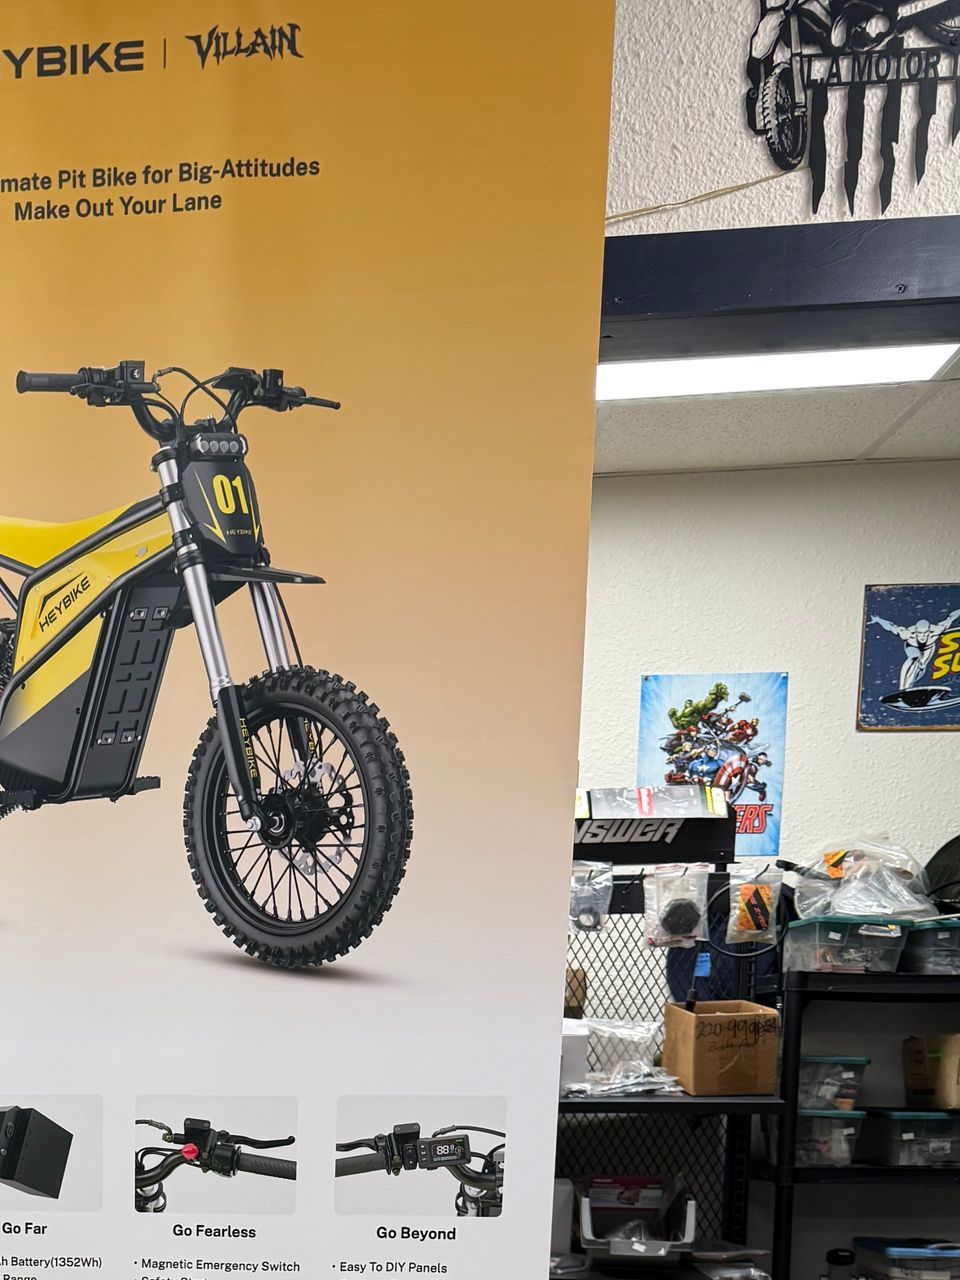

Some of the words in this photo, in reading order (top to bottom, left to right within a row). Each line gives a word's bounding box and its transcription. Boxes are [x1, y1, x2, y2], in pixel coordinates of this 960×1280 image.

[186, 23, 304, 70] VILLAIN
[852, 50, 940, 82] MOTOR
[58, 169, 86, 190] Pit
[93, 166, 137, 188] Bike
[142, 164, 173, 186] for
[179, 157, 320, 186] Big-Attitudes
[15, 200, 70, 222] Make
[76, 198, 114, 219] Out
[119, 195, 167, 216] Your
[172, 192, 222, 214] Lane
[212, 474, 249, 515] 01
[39, 575, 91, 632] HEYBIKE
[240, 717, 259, 780] HEYBIKE
[2, 1222, 22, 1235] Go
[24, 1222, 48, 1235] Far
[172, 1225, 193, 1238] Go
[196, 1224, 257, 1239] Fearless
[376, 1226, 396, 1240] Go
[401, 1227, 456, 1242] Beyond
[11, 1256, 102, 1269] Battery(1352Wh)
[141, 1258, 193, 1272] Magnetic
[196, 1259, 259, 1274] Emergency
[261, 1261, 300, 1272] Switch
[340, 1262, 366, 1276] Easy
[369, 1262, 383, 1273] To
[385, 1262, 406, 1274] DIY
[408, 1262, 447, 1274] Panels
